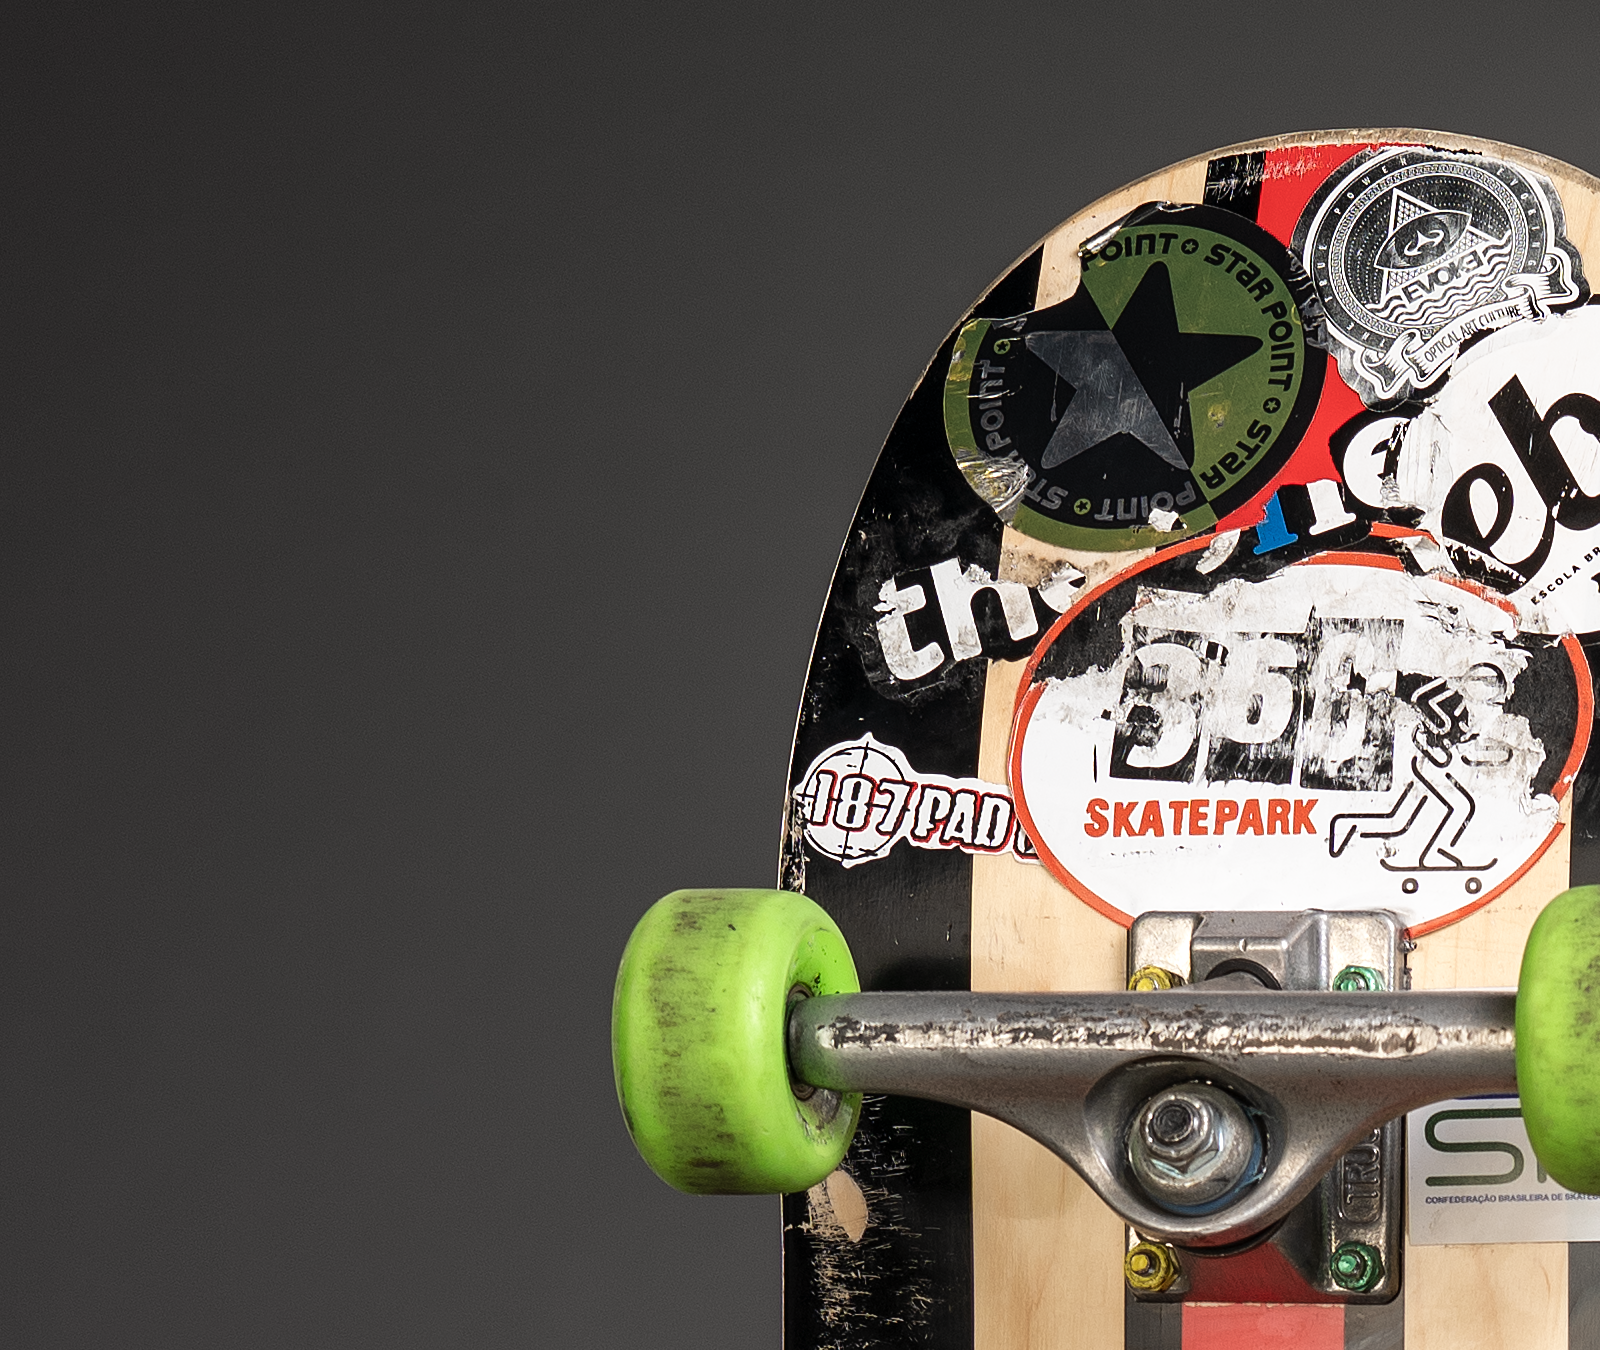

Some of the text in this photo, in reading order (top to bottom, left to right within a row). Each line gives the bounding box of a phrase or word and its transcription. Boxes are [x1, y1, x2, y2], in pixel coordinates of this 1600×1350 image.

[1423, 330, 1462, 363] OPTICAL
[1459, 319, 1481, 339] ART
[1530, 564, 1581, 605] ESCOLA
[807, 769, 918, 836] 187
[1083, 797, 1319, 838] SKATEPARK
[1498, 1193, 1550, 1202] BRASILEIRA
[1550, 1192, 1563, 1201] DE
